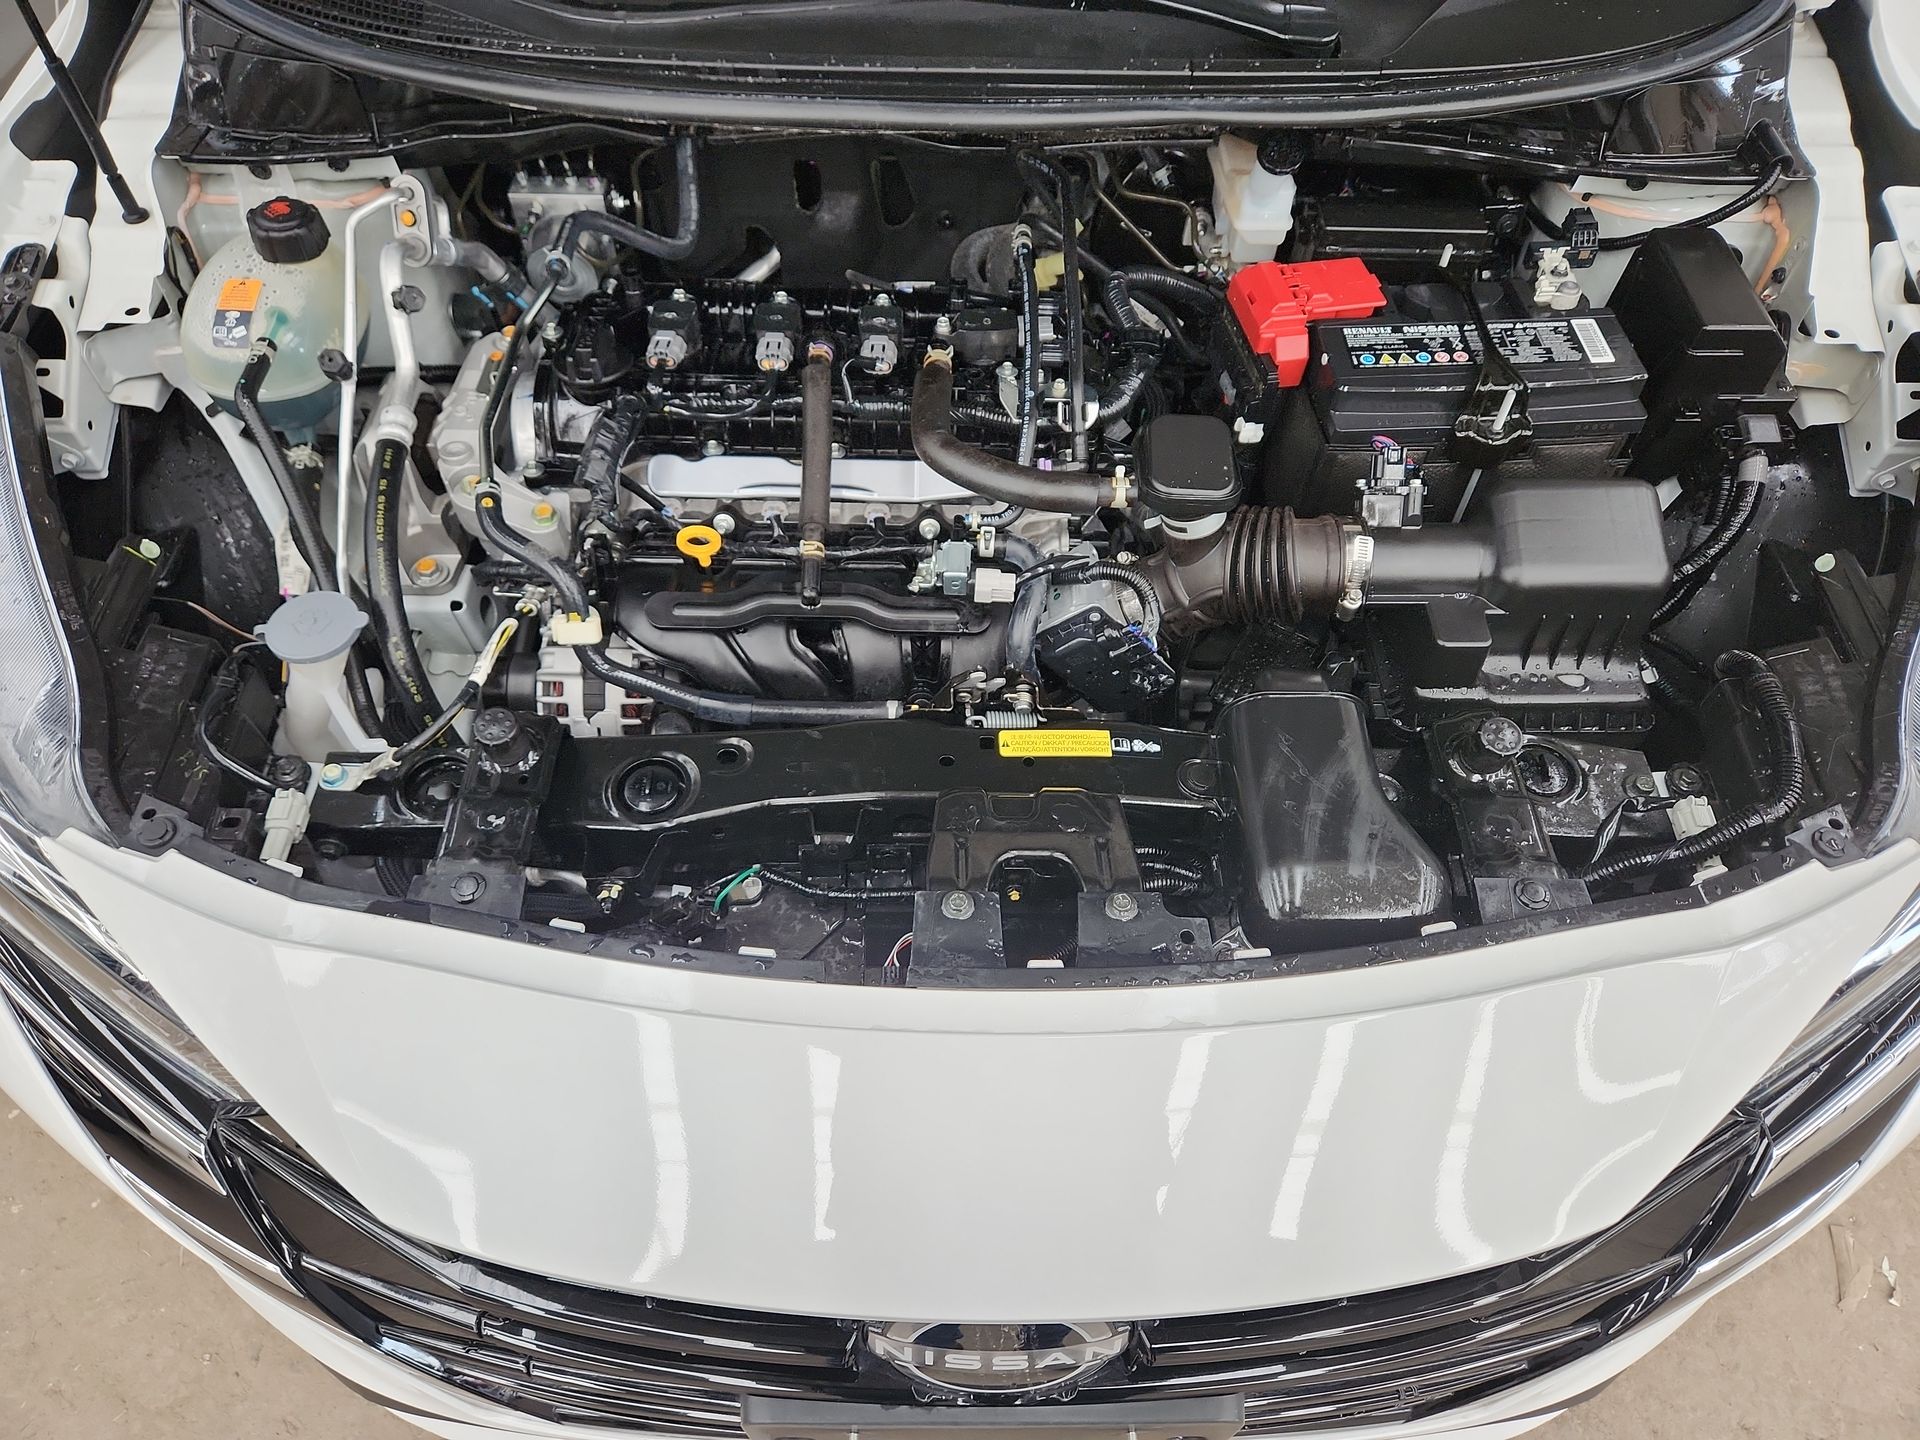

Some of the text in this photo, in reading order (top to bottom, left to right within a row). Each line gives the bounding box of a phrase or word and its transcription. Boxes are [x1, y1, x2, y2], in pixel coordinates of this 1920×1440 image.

[1343, 324, 1459, 335] RENAULT NISSAN
[875, 1337, 1124, 1371] NISSAN
